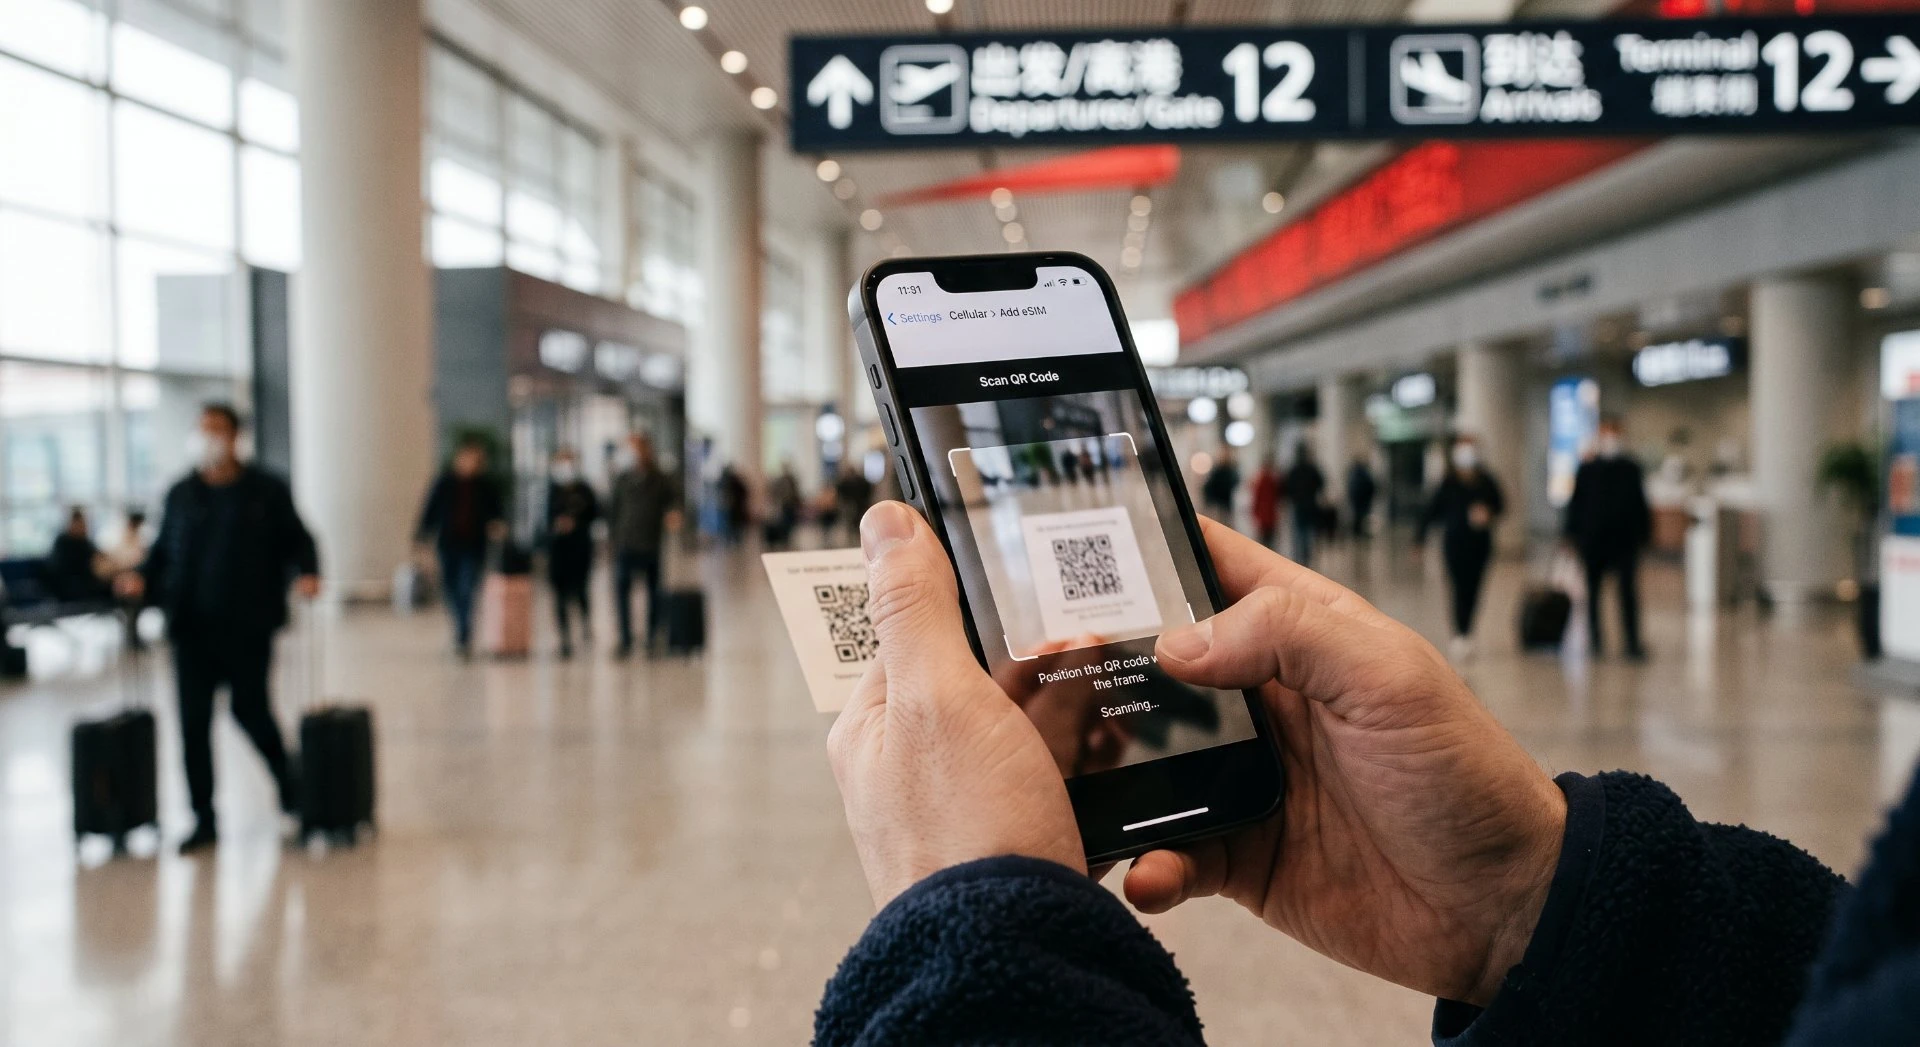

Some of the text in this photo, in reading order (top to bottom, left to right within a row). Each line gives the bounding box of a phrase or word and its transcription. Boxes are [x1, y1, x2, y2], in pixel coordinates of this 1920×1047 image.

[1615, 30, 1758, 72] Terminal
[1762, 30, 1854, 111] 12
[1222, 41, 1316, 122] 12
[1480, 87, 1602, 122] Arrivals
[899, 312, 943, 324] Settings
[949, 306, 1047, 320] Cellular Add eSIM
[979, 371, 1059, 387] Scan QR Code
[1038, 668, 1083, 684] Position
[1083, 664, 1102, 675] the
[1104, 660, 1121, 672] QR
[1123, 655, 1149, 668] code
[1093, 673, 1149, 690] the frame.
[1100, 700, 1160, 718] Scanning...
